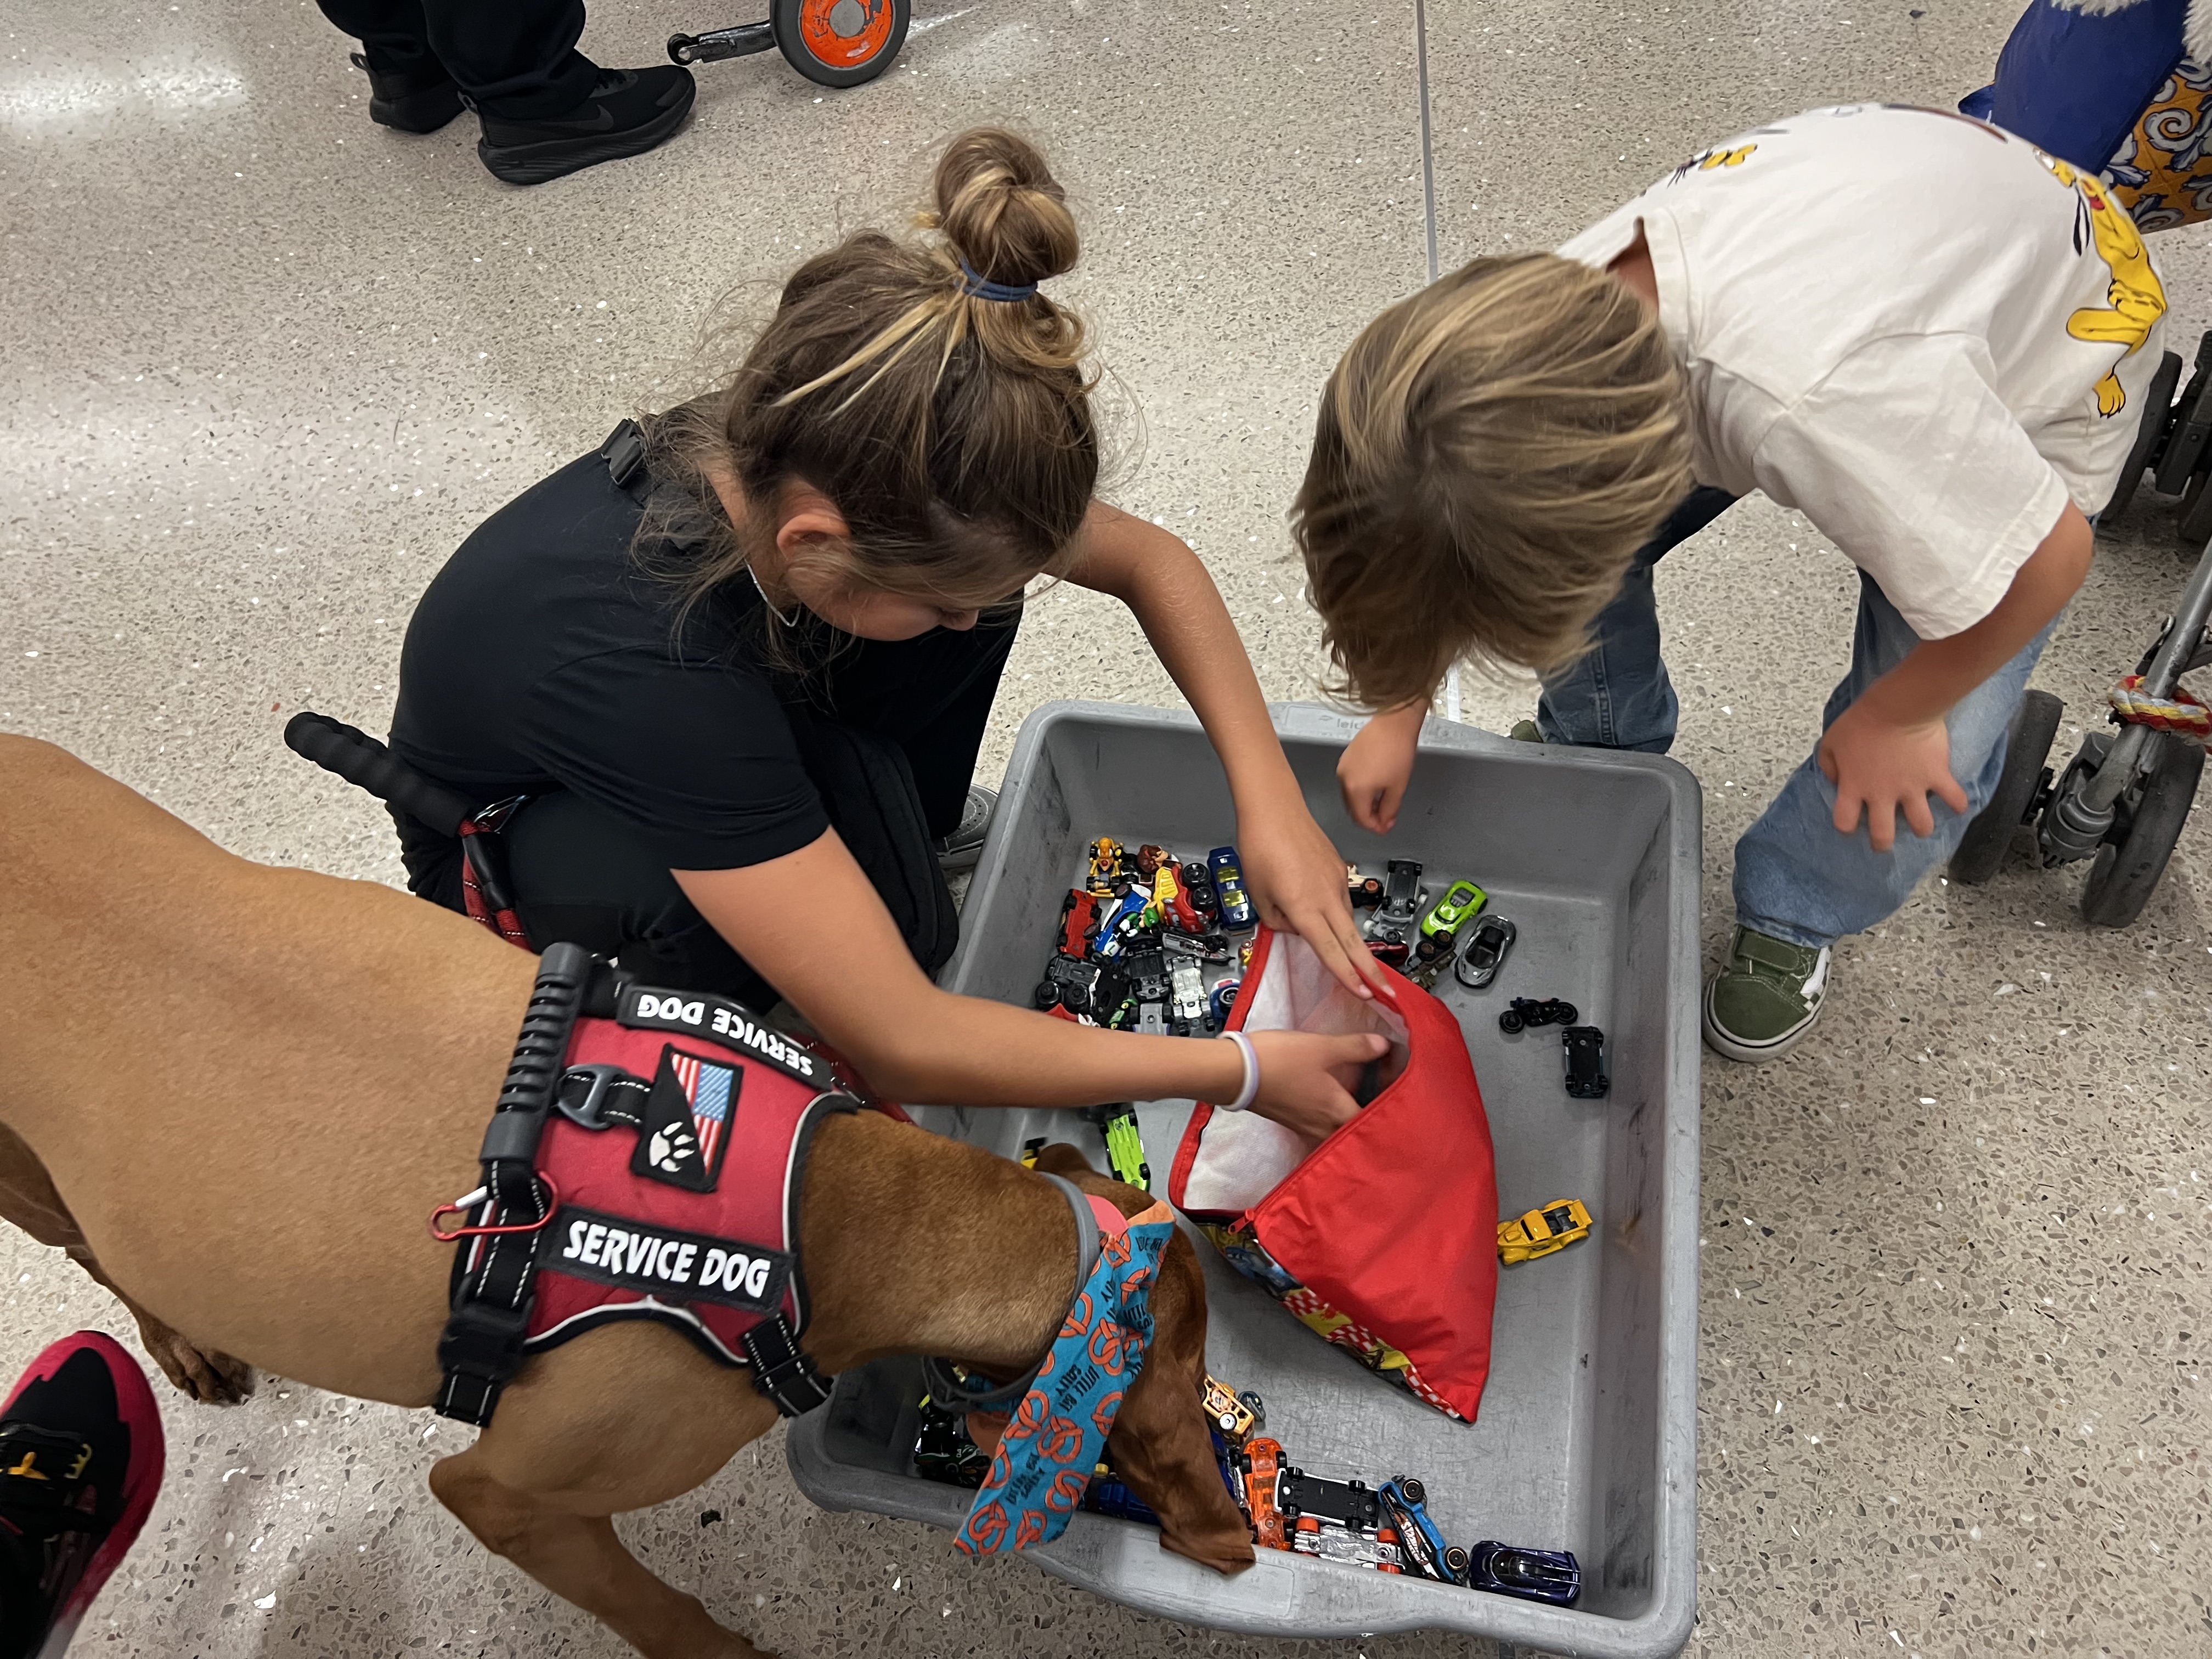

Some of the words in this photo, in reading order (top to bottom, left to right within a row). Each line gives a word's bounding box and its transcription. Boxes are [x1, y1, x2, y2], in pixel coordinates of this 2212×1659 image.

[637, 994, 706, 1025] DOG
[712, 1007, 813, 1076] SERVICE
[563, 1220, 698, 1283] SERVICE
[698, 1248, 771, 1298] DOG
